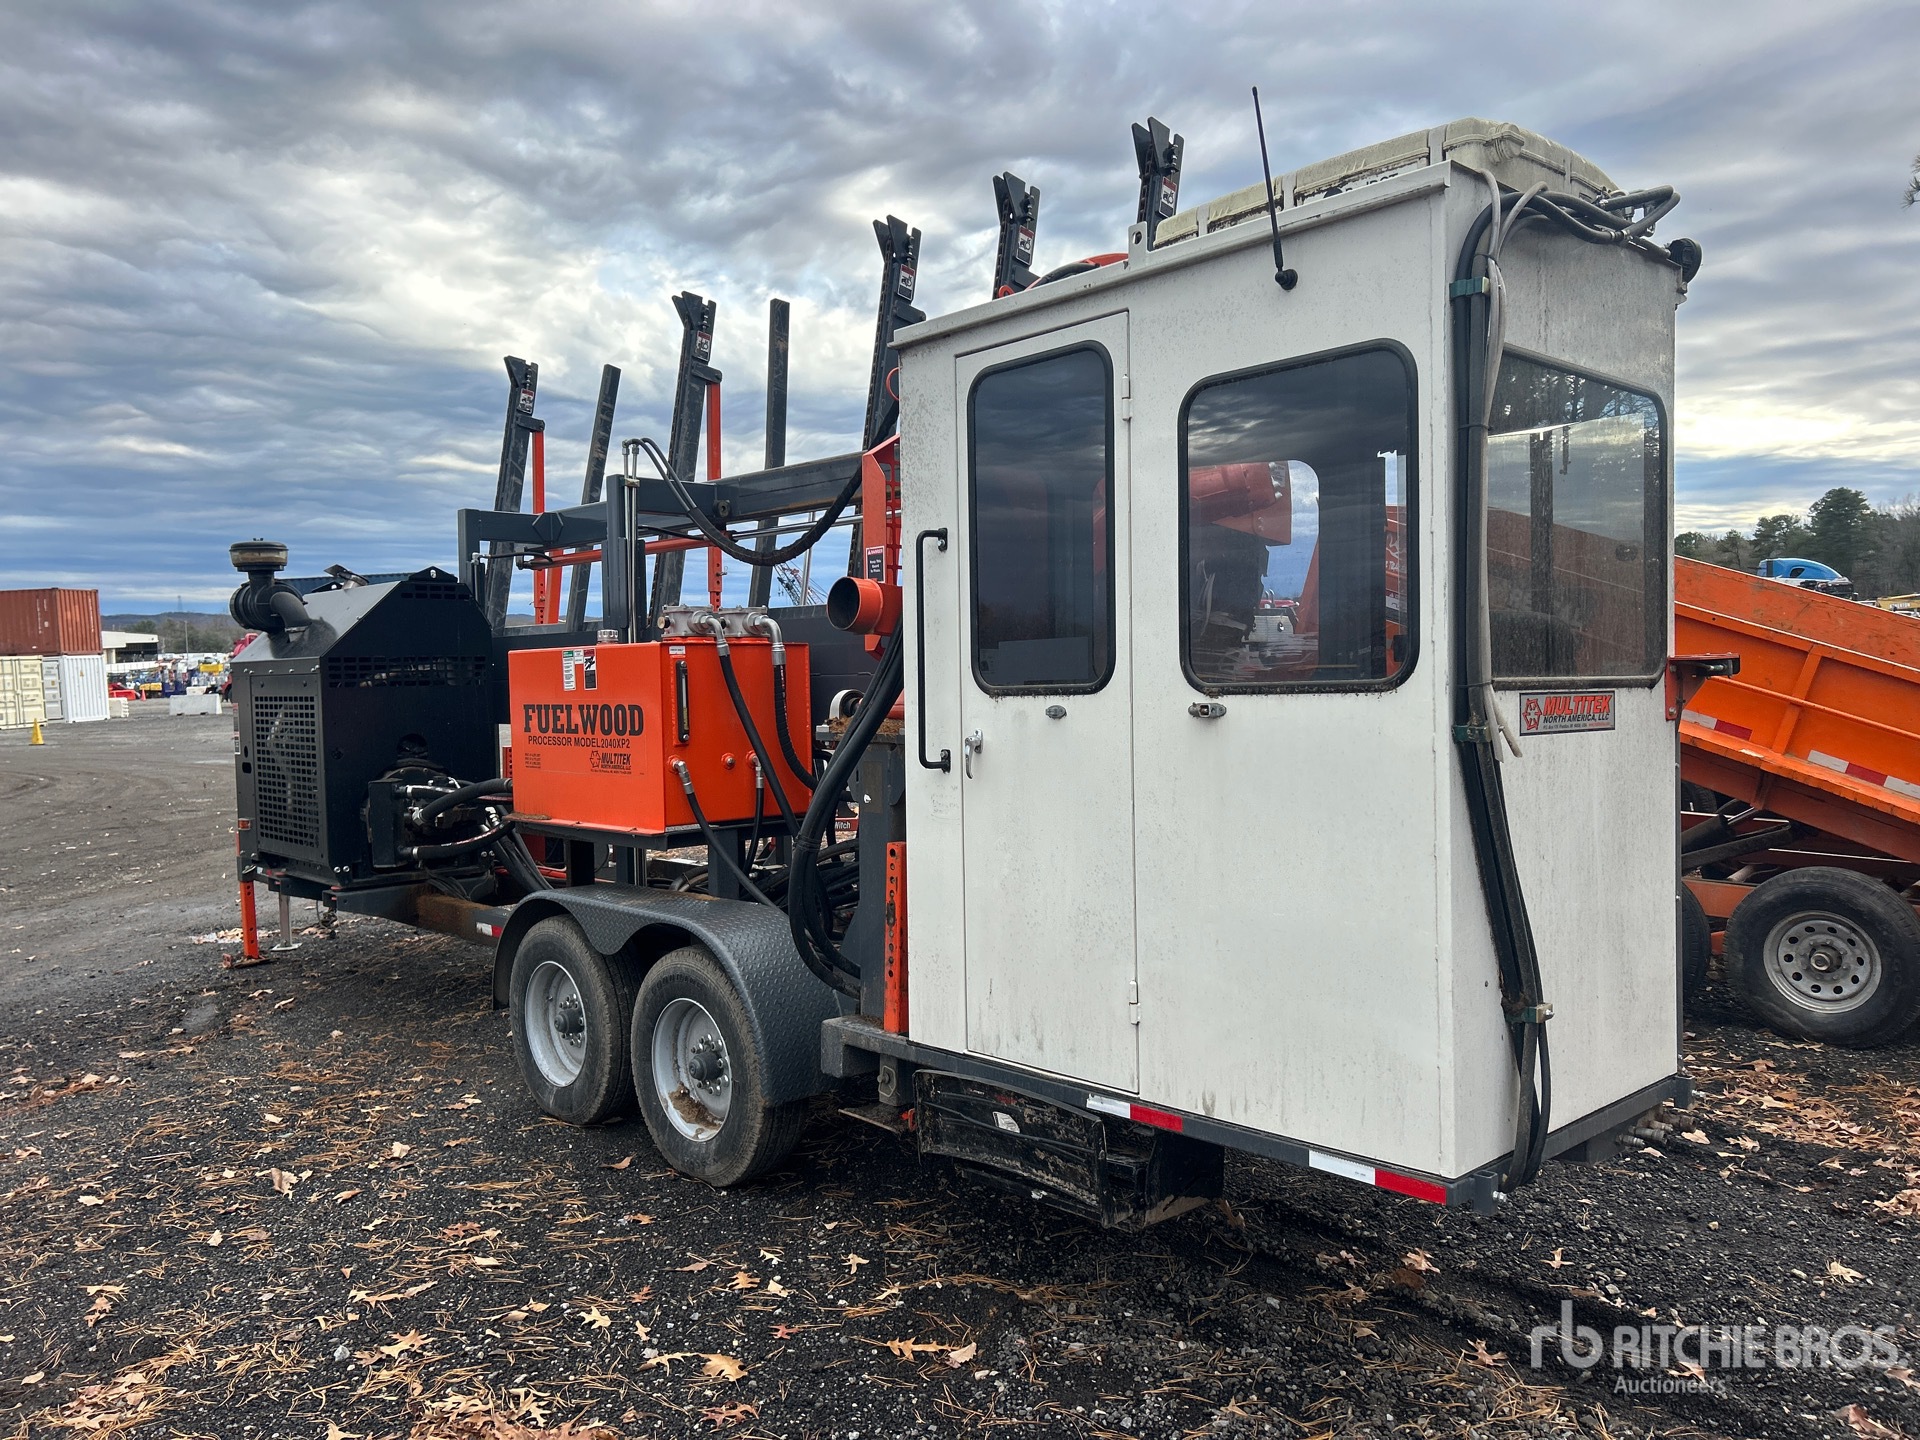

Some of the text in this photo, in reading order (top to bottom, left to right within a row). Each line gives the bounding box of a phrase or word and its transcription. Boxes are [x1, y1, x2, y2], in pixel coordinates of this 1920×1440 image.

[1543, 695, 1612, 716] MULTITEK
[523, 704, 644, 736] FUELWOOD
[1543, 713, 1610, 724] NORTH AMERICA, LLC
[528, 735, 631, 749] PROCESSOR MODEL 2040XP2
[601, 752, 631, 765] MULTITEK
